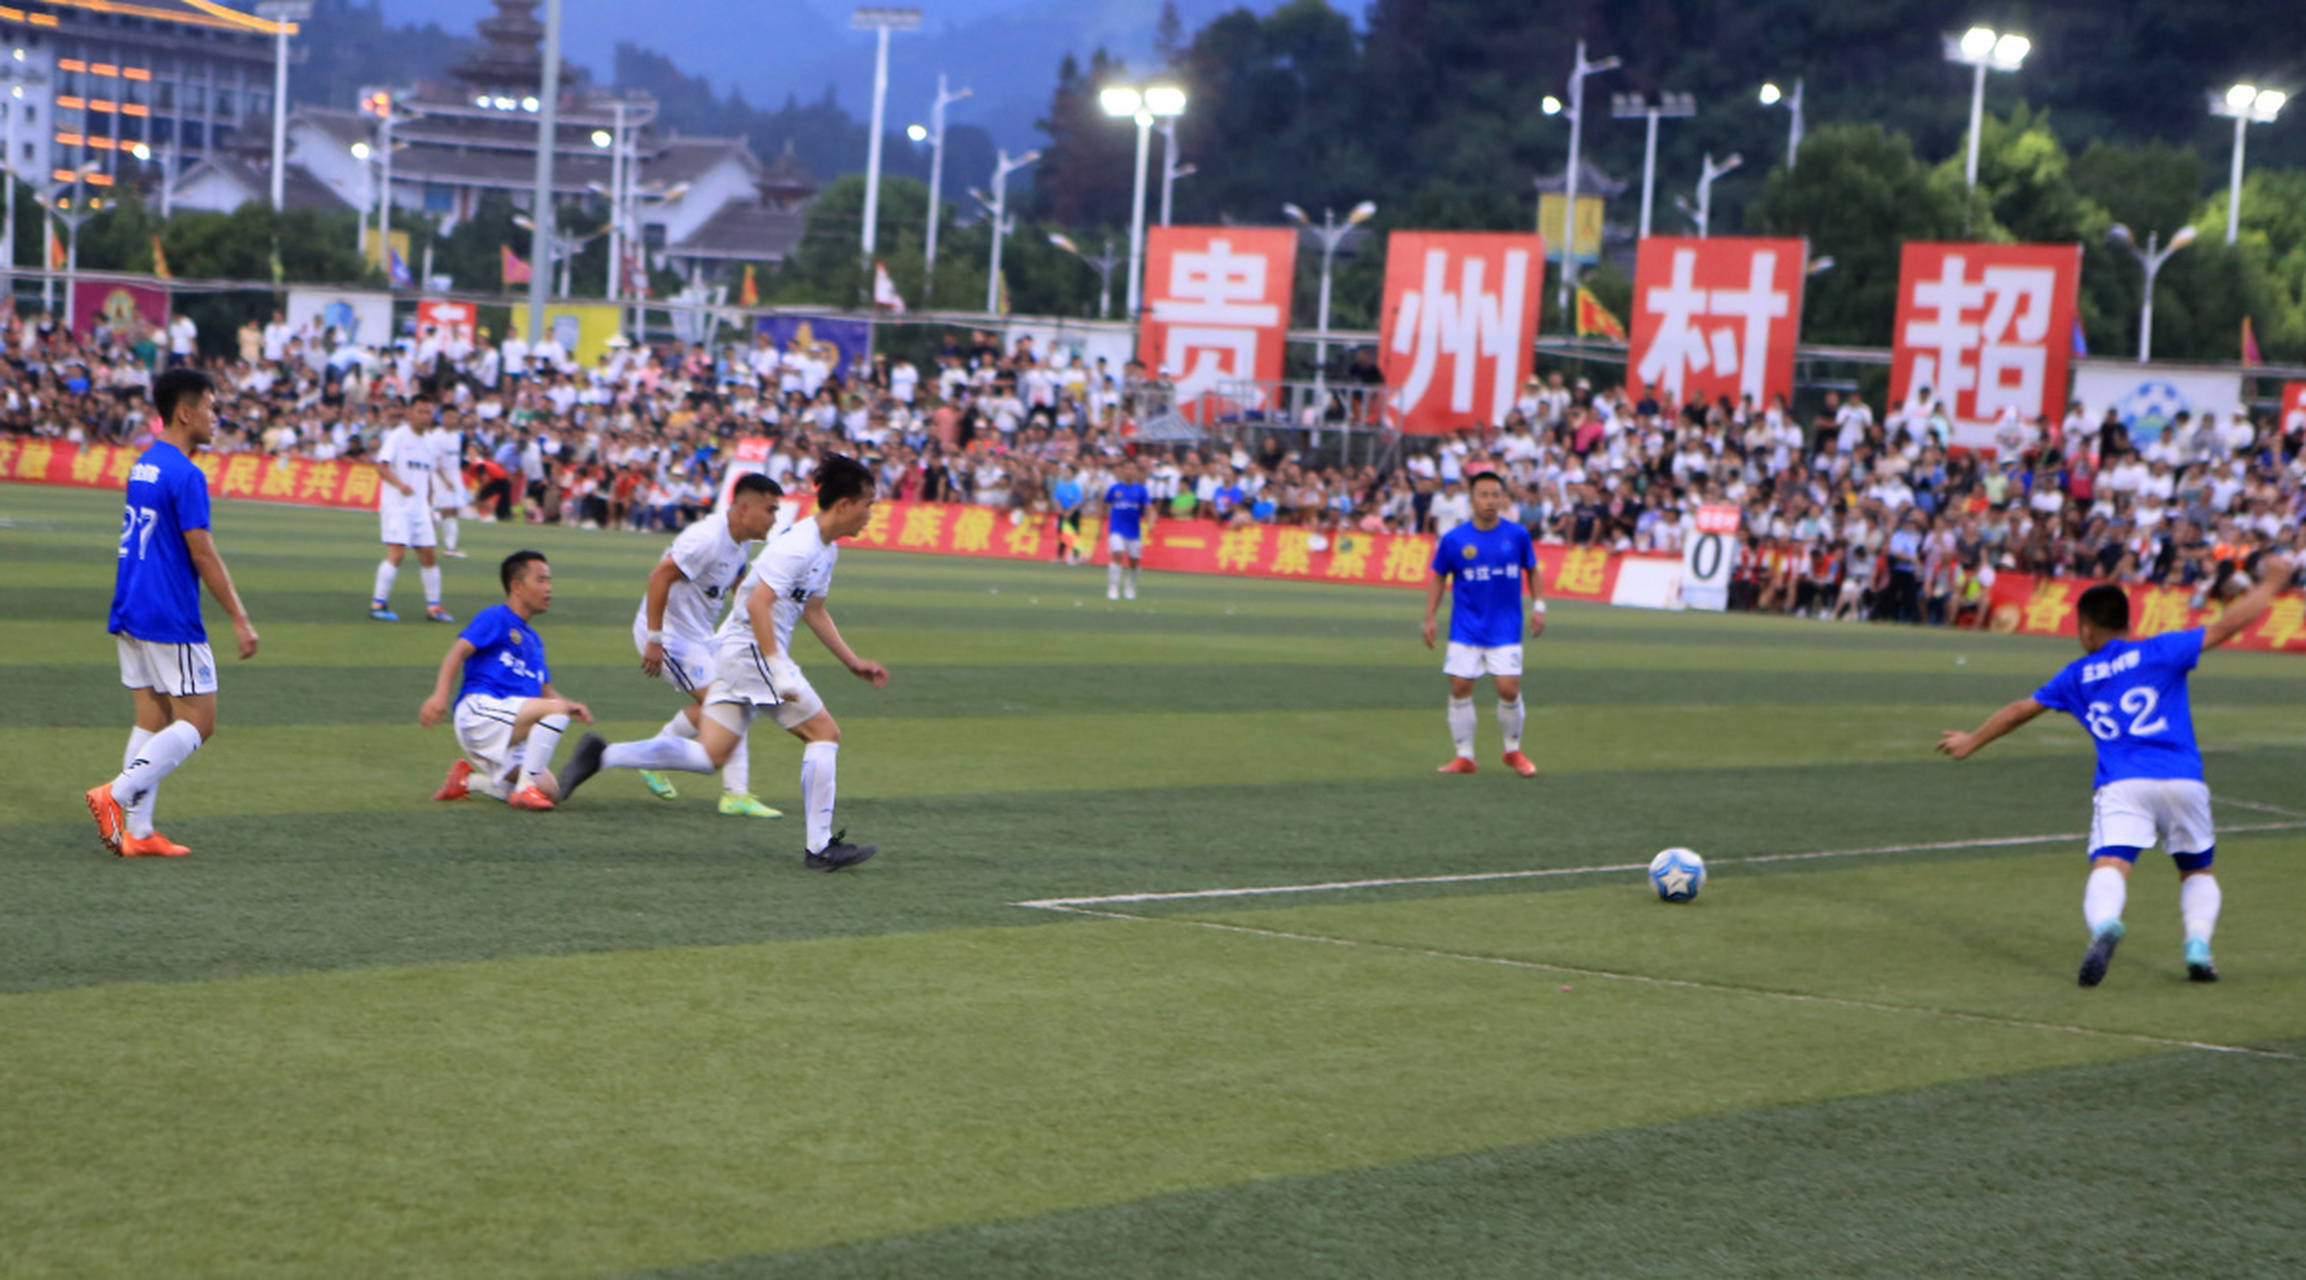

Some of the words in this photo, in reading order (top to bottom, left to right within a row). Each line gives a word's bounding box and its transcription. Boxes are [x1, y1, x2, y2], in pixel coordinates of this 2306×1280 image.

[1152, 238, 1280, 412] 贵
[1390, 247, 1529, 428] 州
[1637, 247, 1789, 412] 村
[1904, 254, 2056, 450] 超
[1692, 532, 1722, 580] 0
[2085, 686, 2169, 741] 62
